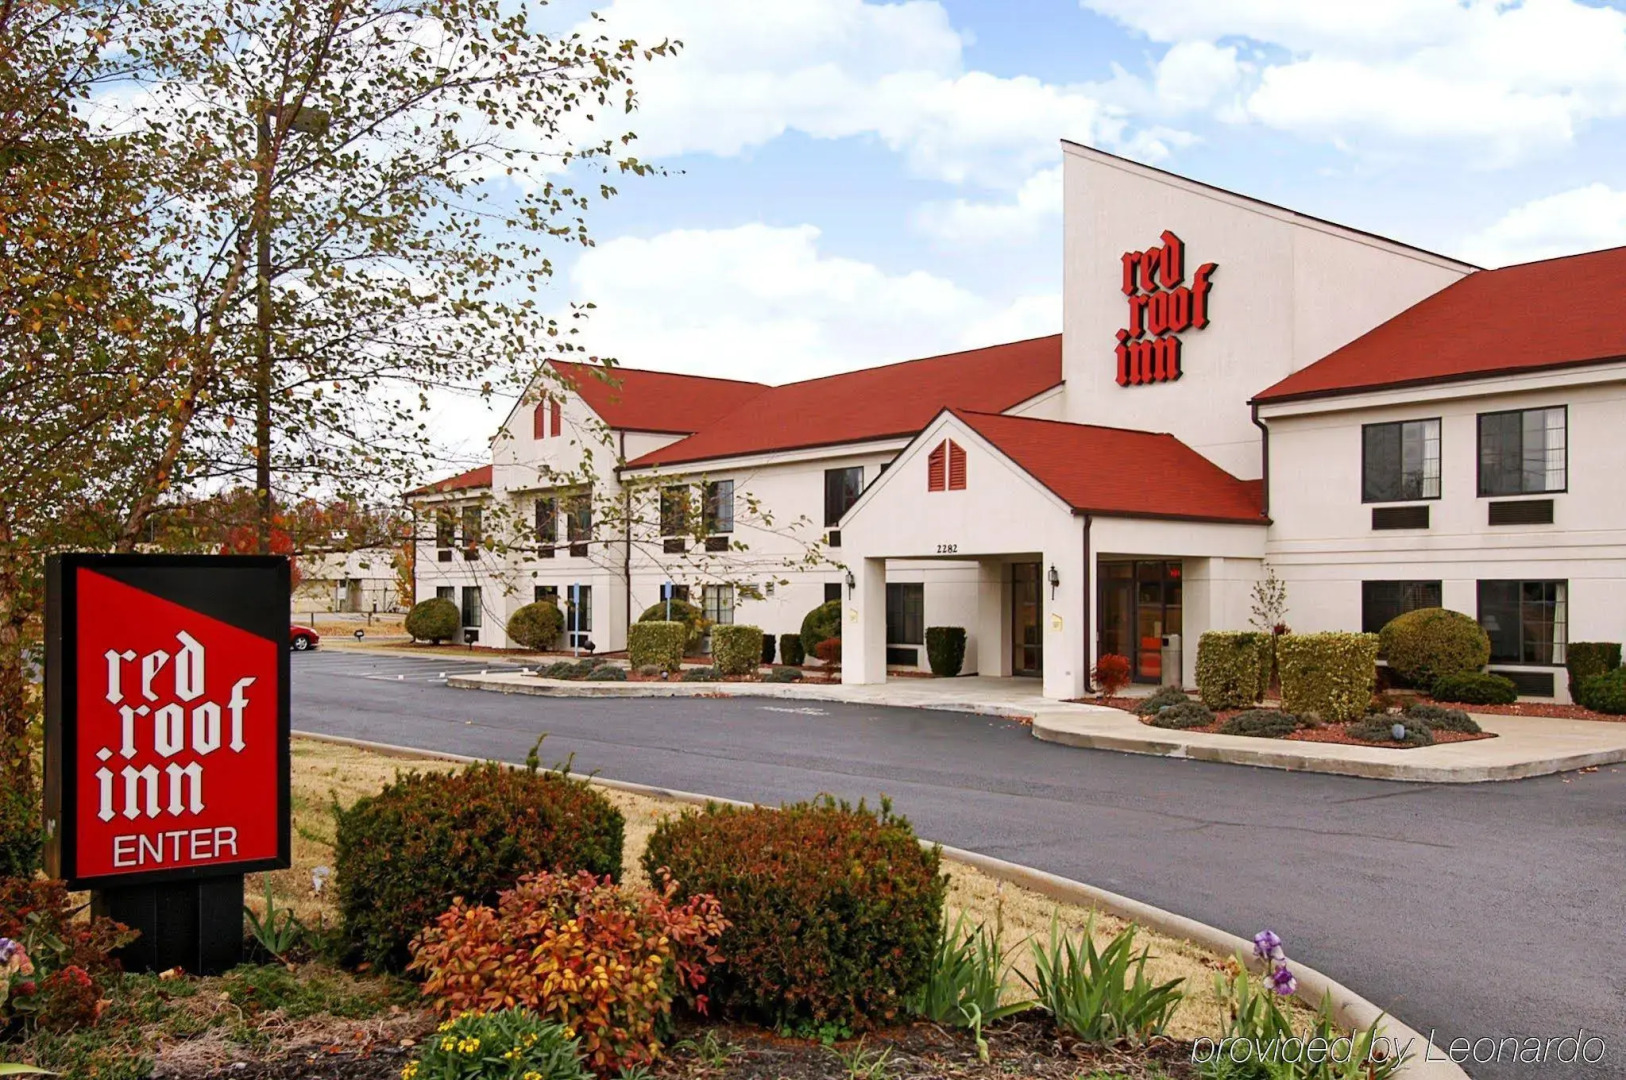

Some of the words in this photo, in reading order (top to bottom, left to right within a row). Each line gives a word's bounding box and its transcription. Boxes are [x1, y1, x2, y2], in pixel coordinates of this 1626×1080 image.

[1121, 229, 1185, 296] red
[1128, 262, 1219, 339] roof
[1114, 328, 1183, 388] inn
[936, 544, 958, 554] 2282
[104, 630, 205, 705] red
[118, 677, 257, 760] roof
[95, 747, 205, 822] inn
[113, 826, 238, 867] ENTER
